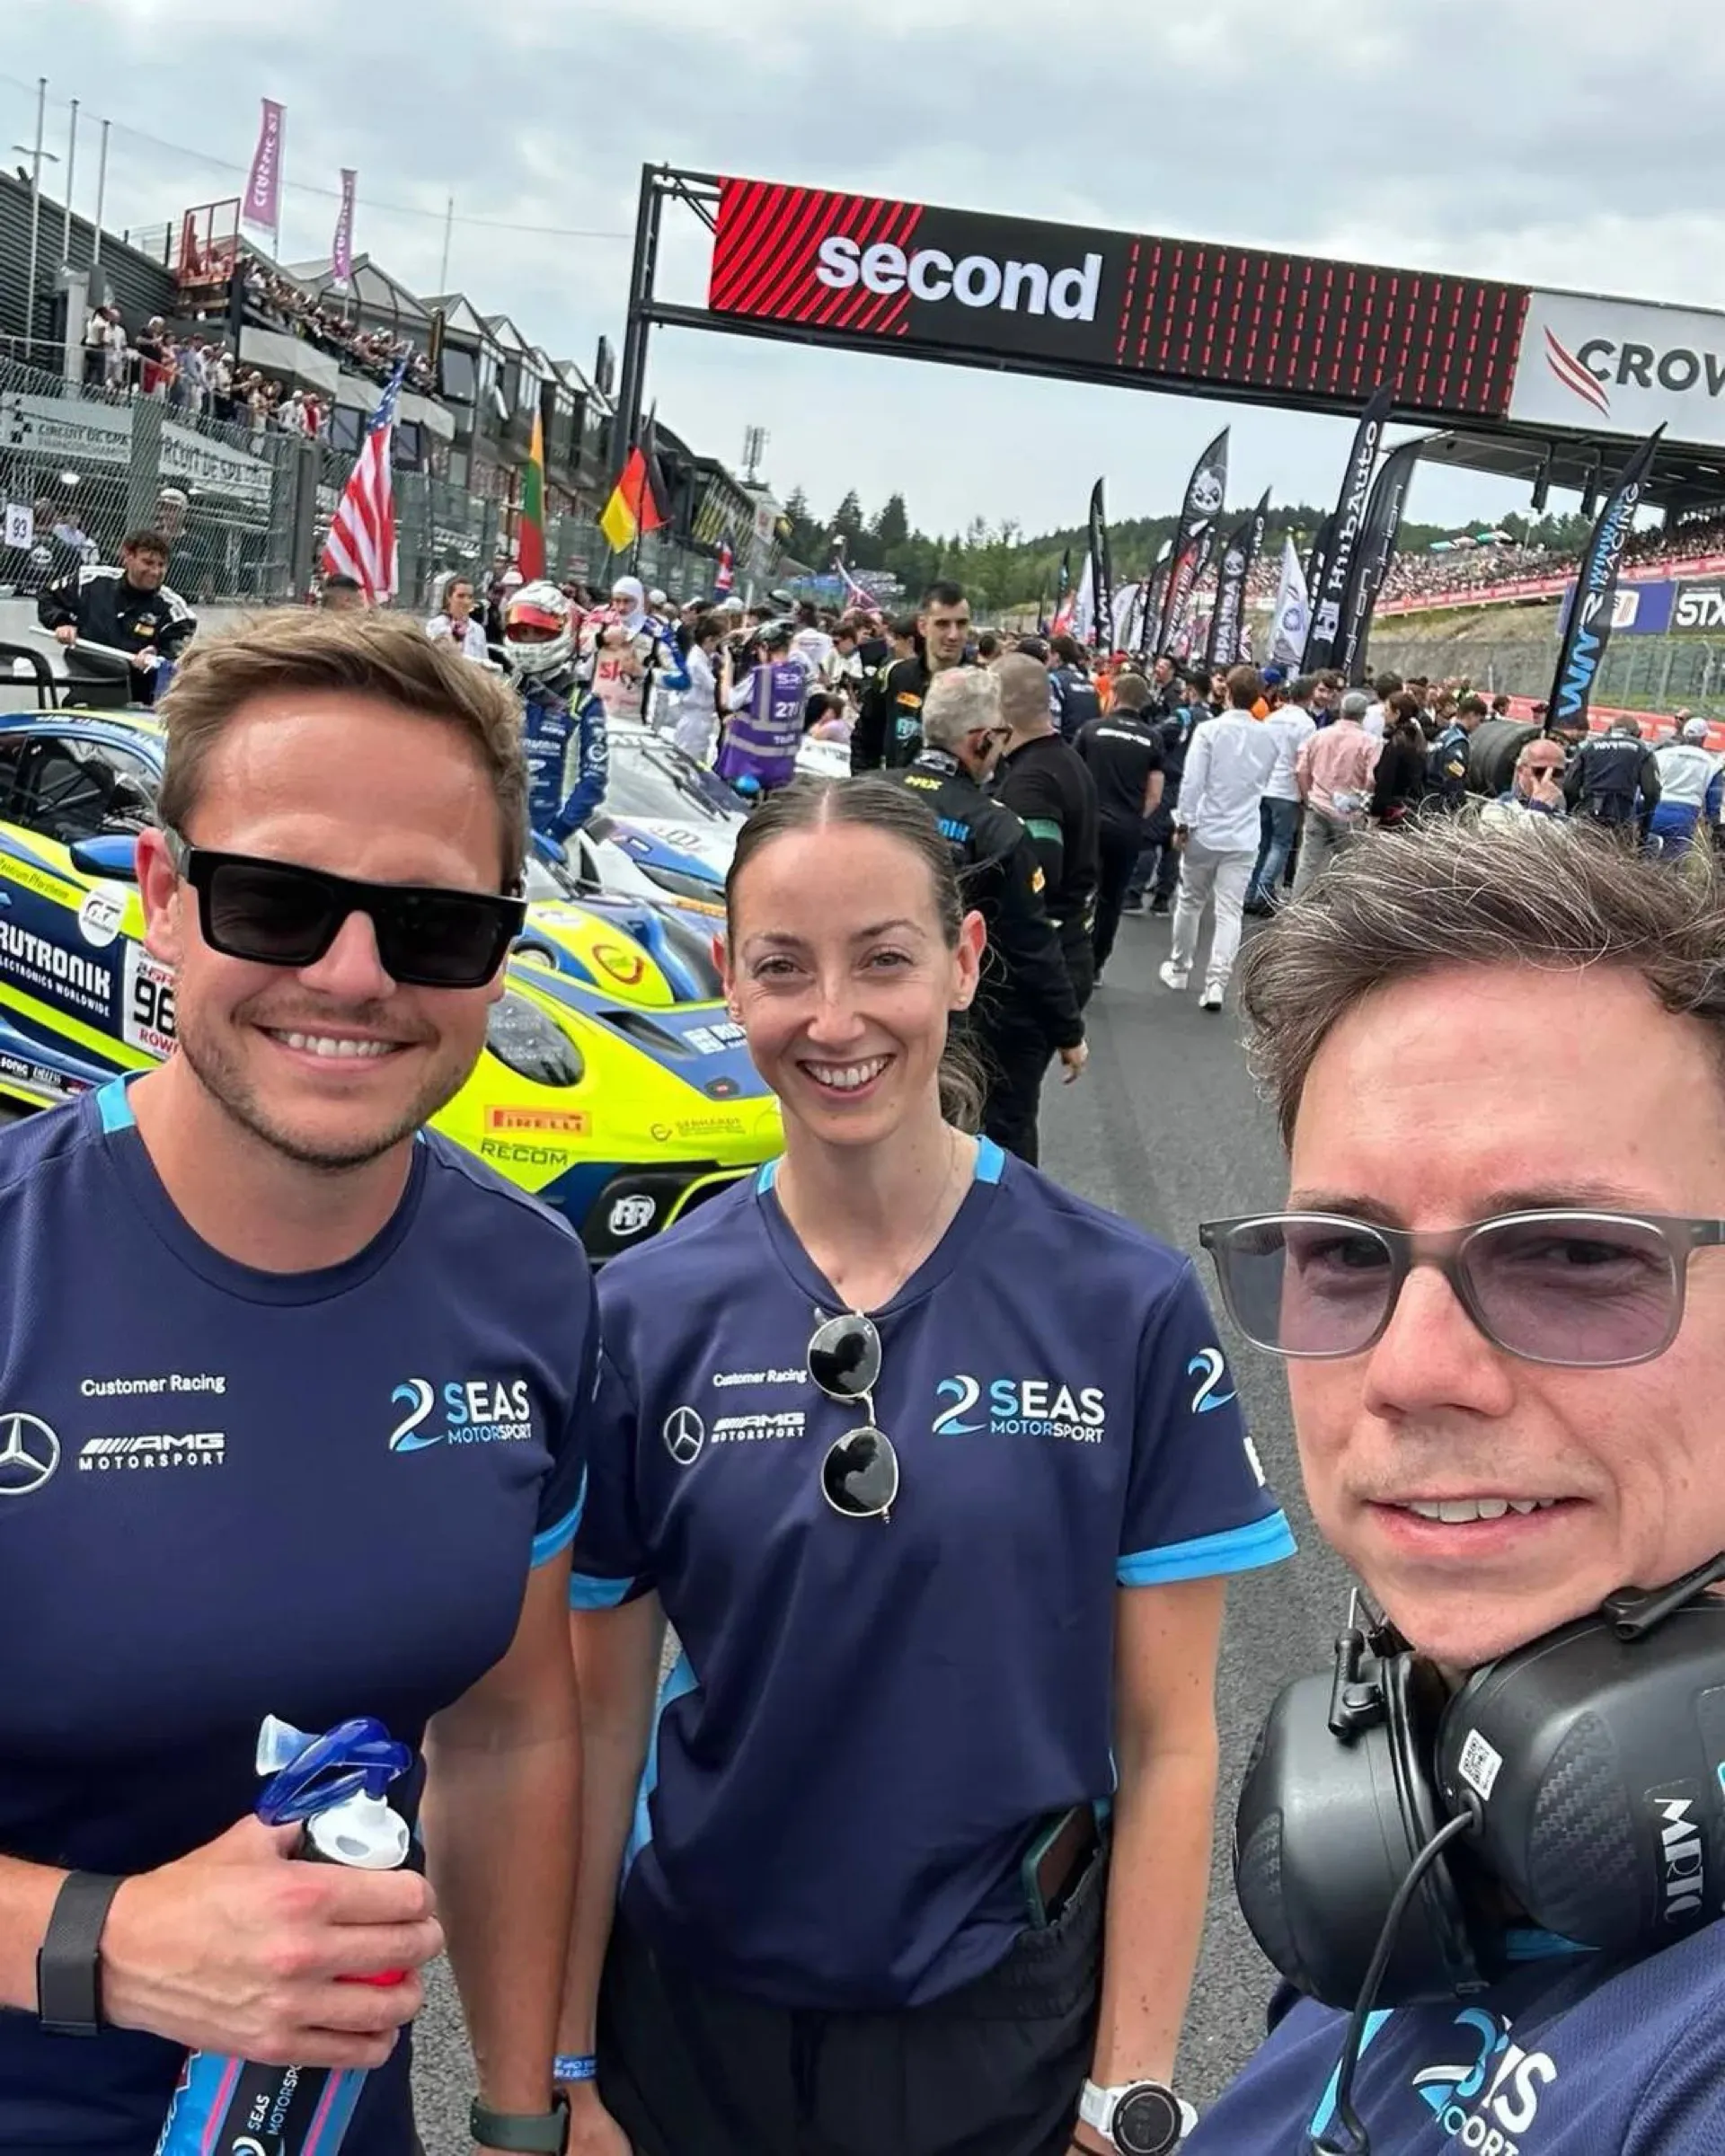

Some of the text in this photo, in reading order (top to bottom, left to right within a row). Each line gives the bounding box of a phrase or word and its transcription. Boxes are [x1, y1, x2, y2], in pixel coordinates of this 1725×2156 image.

[817, 236, 1103, 321] second
[1329, 420, 1377, 592] HubAuto
[13, 517, 28, 540] 93
[55, 977, 111, 1018] WORLDWIDE
[134, 976, 176, 1037] 96
[492, 1109, 582, 1134] PIRELLI
[480, 1138, 569, 1166] RECOM
[81, 1374, 226, 1397] Customer Racing
[712, 1368, 808, 1388] Customer Racing
[1186, 1347, 1240, 1414] 2
[389, 1378, 530, 1453] 2 SEAS
[932, 1374, 1105, 1436] 2 SEAS
[743, 1411, 806, 1427] AMG
[991, 1418, 1105, 1445] MOTORSPORT
[133, 1432, 225, 1452] AMG
[448, 1422, 532, 1445] MOTORSPORT
[711, 1427, 806, 1444] MOTORSPORT
[79, 1452, 225, 1471] MOTORSPORT
[247, 2093, 270, 2131] SEAS
